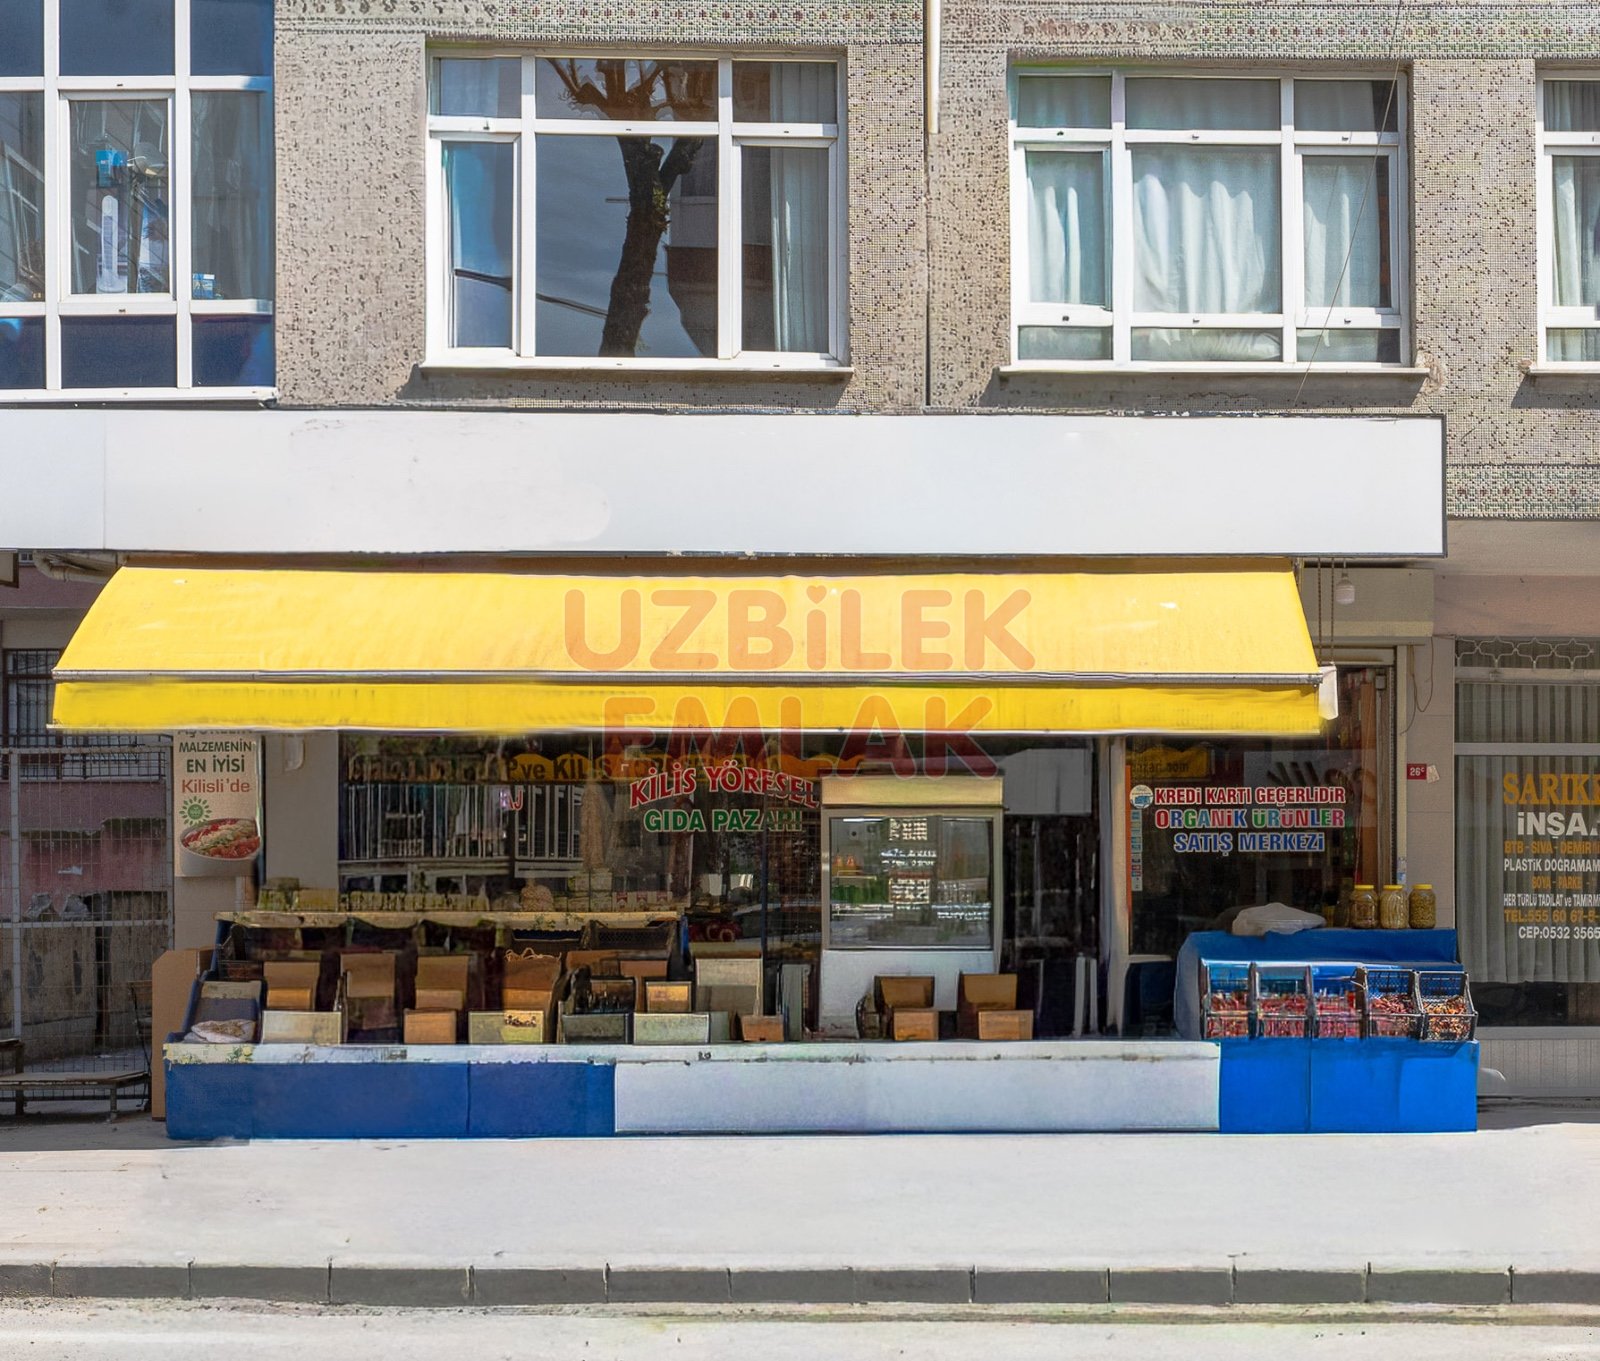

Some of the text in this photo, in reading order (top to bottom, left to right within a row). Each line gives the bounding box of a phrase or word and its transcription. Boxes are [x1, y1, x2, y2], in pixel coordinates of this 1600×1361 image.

[179, 739, 252, 753] MALZEMENİN
[187, 755, 245, 773] EN İYİSİ
[553, 752, 612, 780] KİLS
[629, 762, 696, 809] KİLİS
[704, 759, 819, 808] YÖRESEL
[1205, 787, 1251, 804] KARTI
[643, 809, 802, 832] GIDA PAZARI
[1252, 808, 1345, 828] ÜRÜNLER
[1174, 832, 1233, 856] SATIŞ
[1518, 926, 1570, 939] CEP:0532
